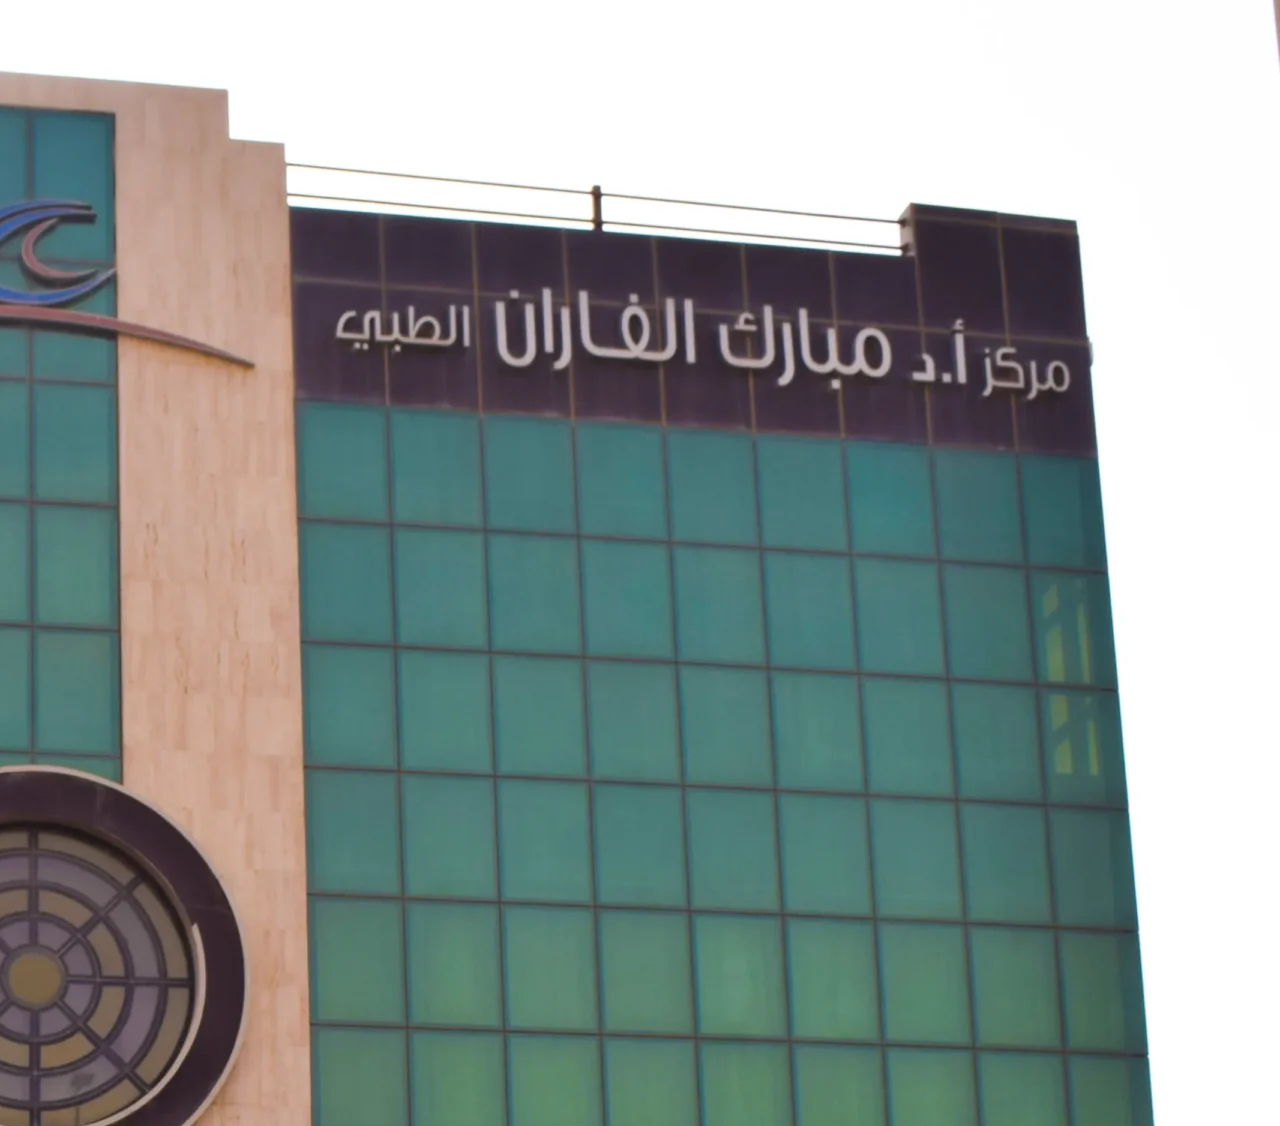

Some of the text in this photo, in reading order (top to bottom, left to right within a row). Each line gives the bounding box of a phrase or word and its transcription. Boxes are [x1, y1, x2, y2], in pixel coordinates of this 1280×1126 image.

[335, 304, 471, 353] الطبي
[494, 287, 697, 371] الفاران
[718, 304, 893, 390] مبارك
[982, 346, 1071, 401] مركز
